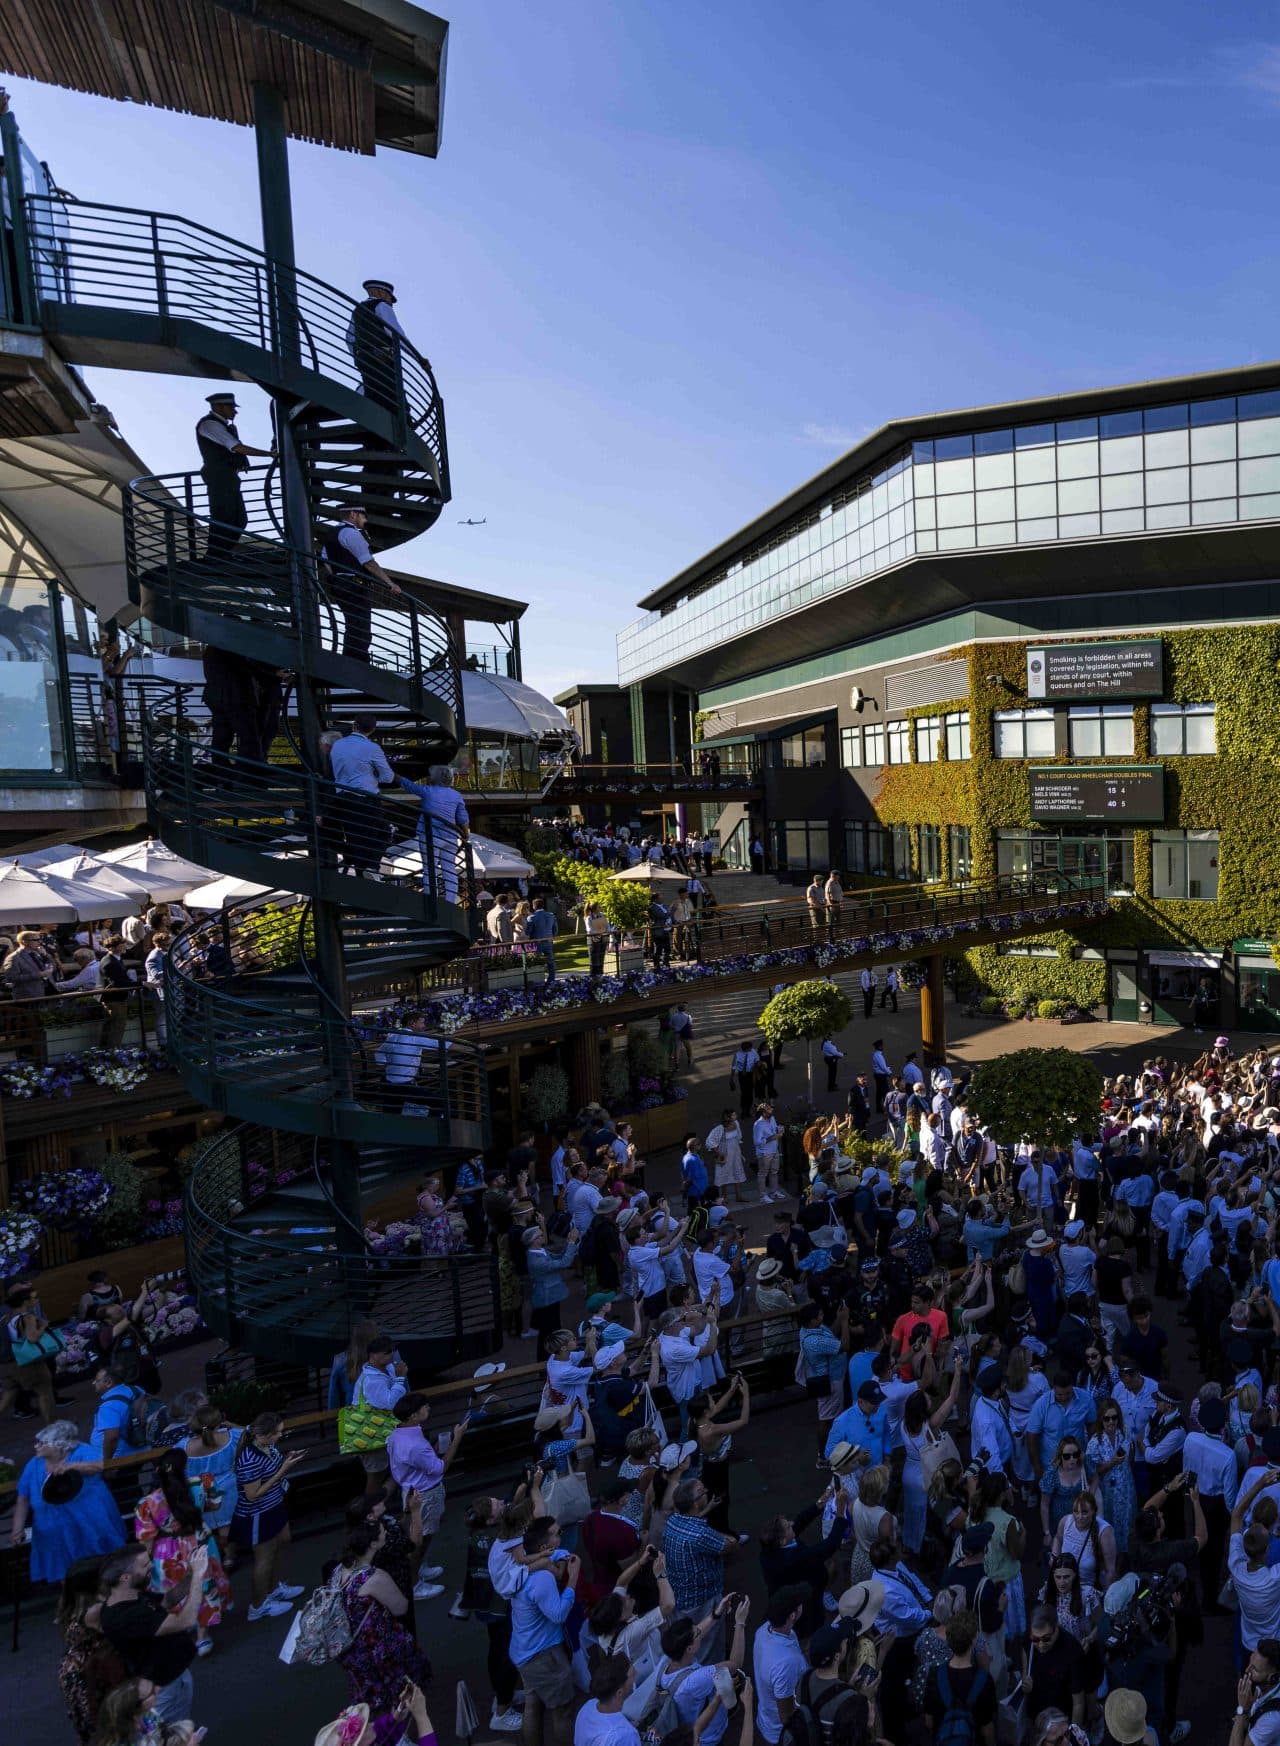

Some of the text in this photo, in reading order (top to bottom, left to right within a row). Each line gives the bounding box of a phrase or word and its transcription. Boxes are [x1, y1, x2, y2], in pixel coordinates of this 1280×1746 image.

[1049, 656, 1076, 664] Smoking
[1085, 654, 1116, 662] forbidden
[1050, 664, 1075, 672] covered
[1076, 664, 1084, 672] by
[1050, 673, 1070, 681] stands
[1113, 670, 1132, 678] within
[1050, 682, 1072, 690] queues
